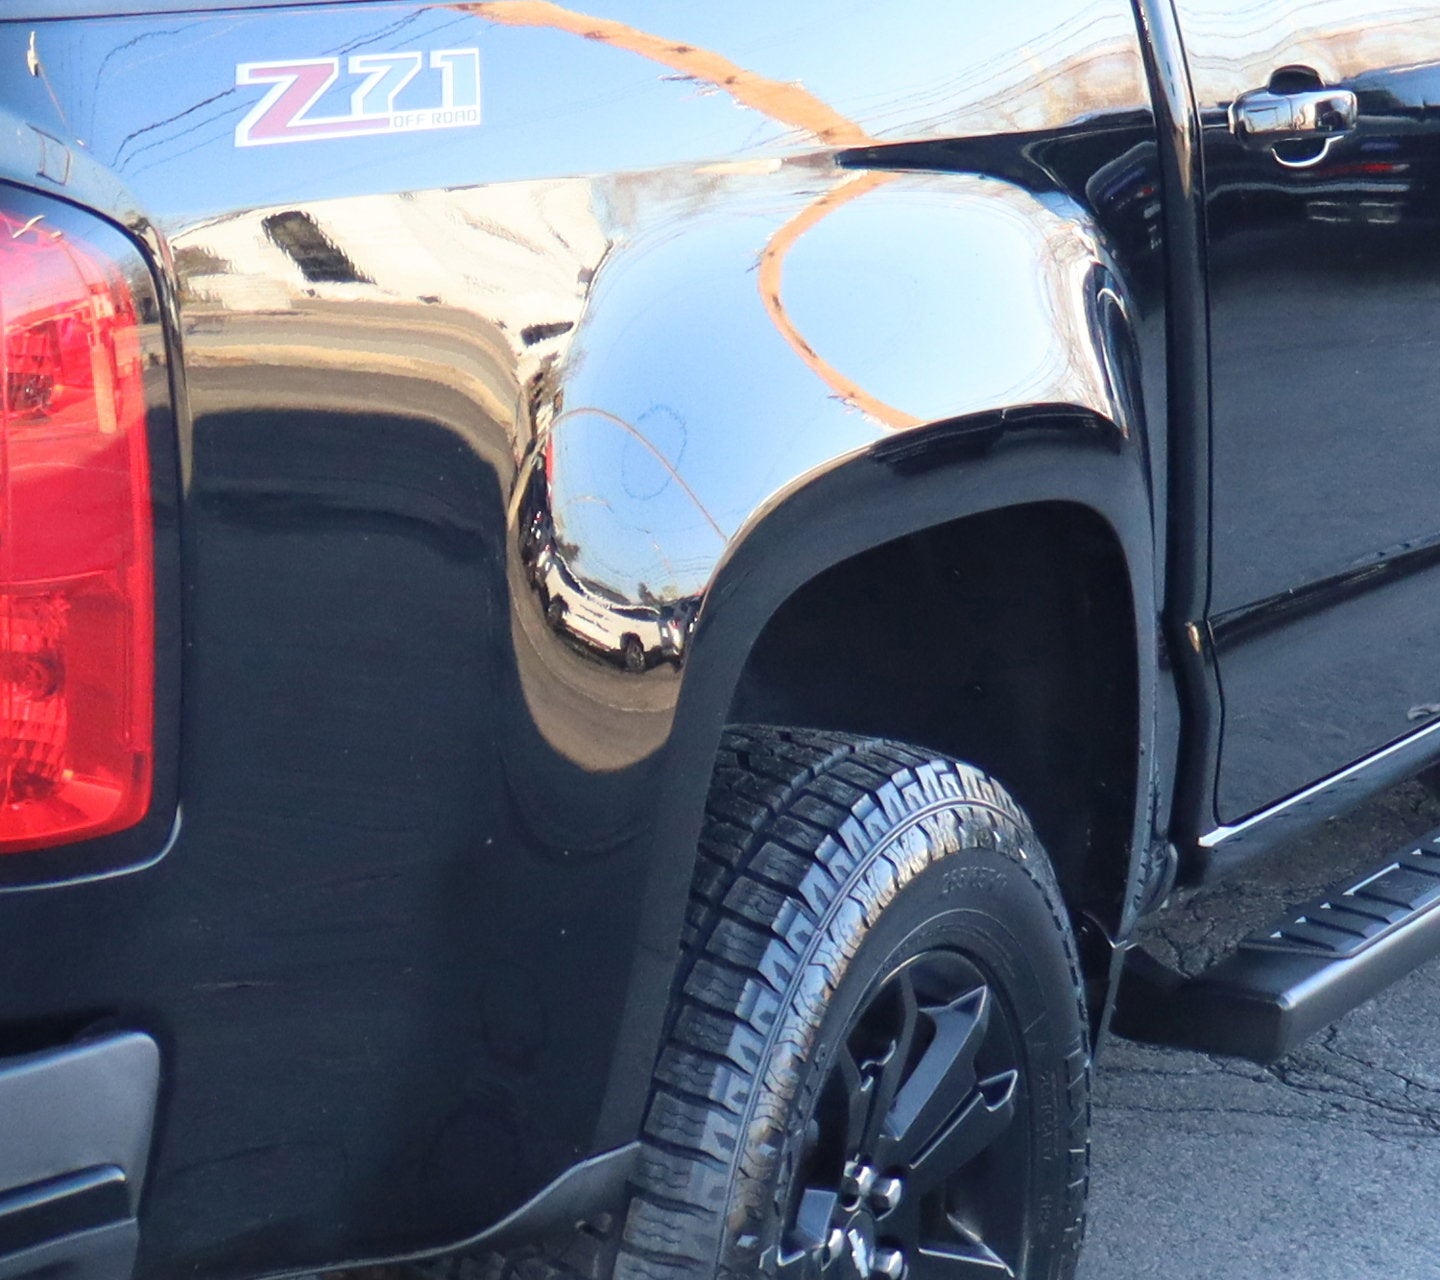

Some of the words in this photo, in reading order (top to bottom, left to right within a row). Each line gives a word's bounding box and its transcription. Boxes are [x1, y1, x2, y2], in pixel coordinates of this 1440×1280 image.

[233, 47, 481, 148] Z71
[393, 111, 424, 128] OFF
[431, 108, 478, 125] ROAD
